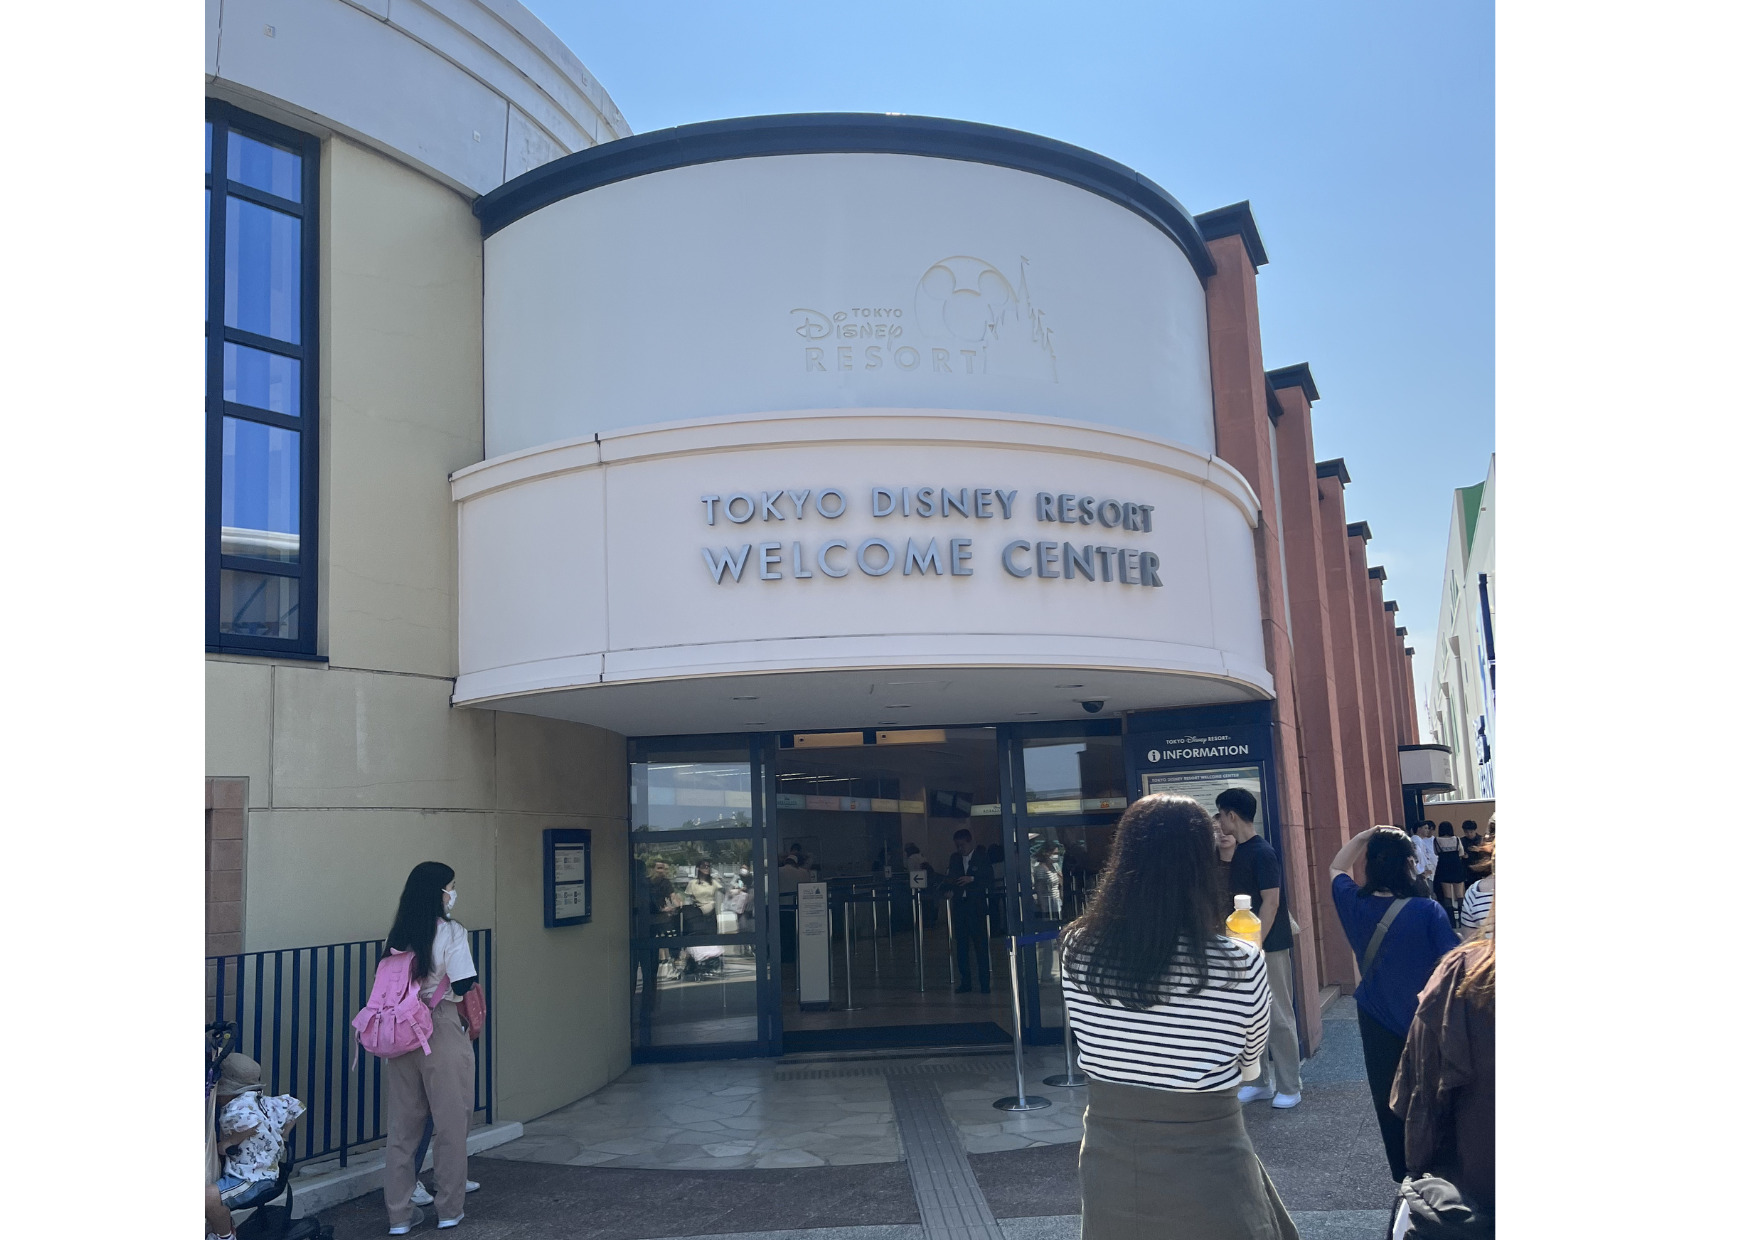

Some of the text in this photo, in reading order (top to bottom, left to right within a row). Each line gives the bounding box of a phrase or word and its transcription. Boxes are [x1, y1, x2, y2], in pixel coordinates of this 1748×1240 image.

[852, 308, 903, 318] TOKYO
[805, 346, 976, 374] RESORT
[702, 486, 1156, 533] TOKYO DISNEY RESORT
[703, 537, 1164, 588] WELCOME CENTER
[1163, 745, 1249, 760] INFORMATION
